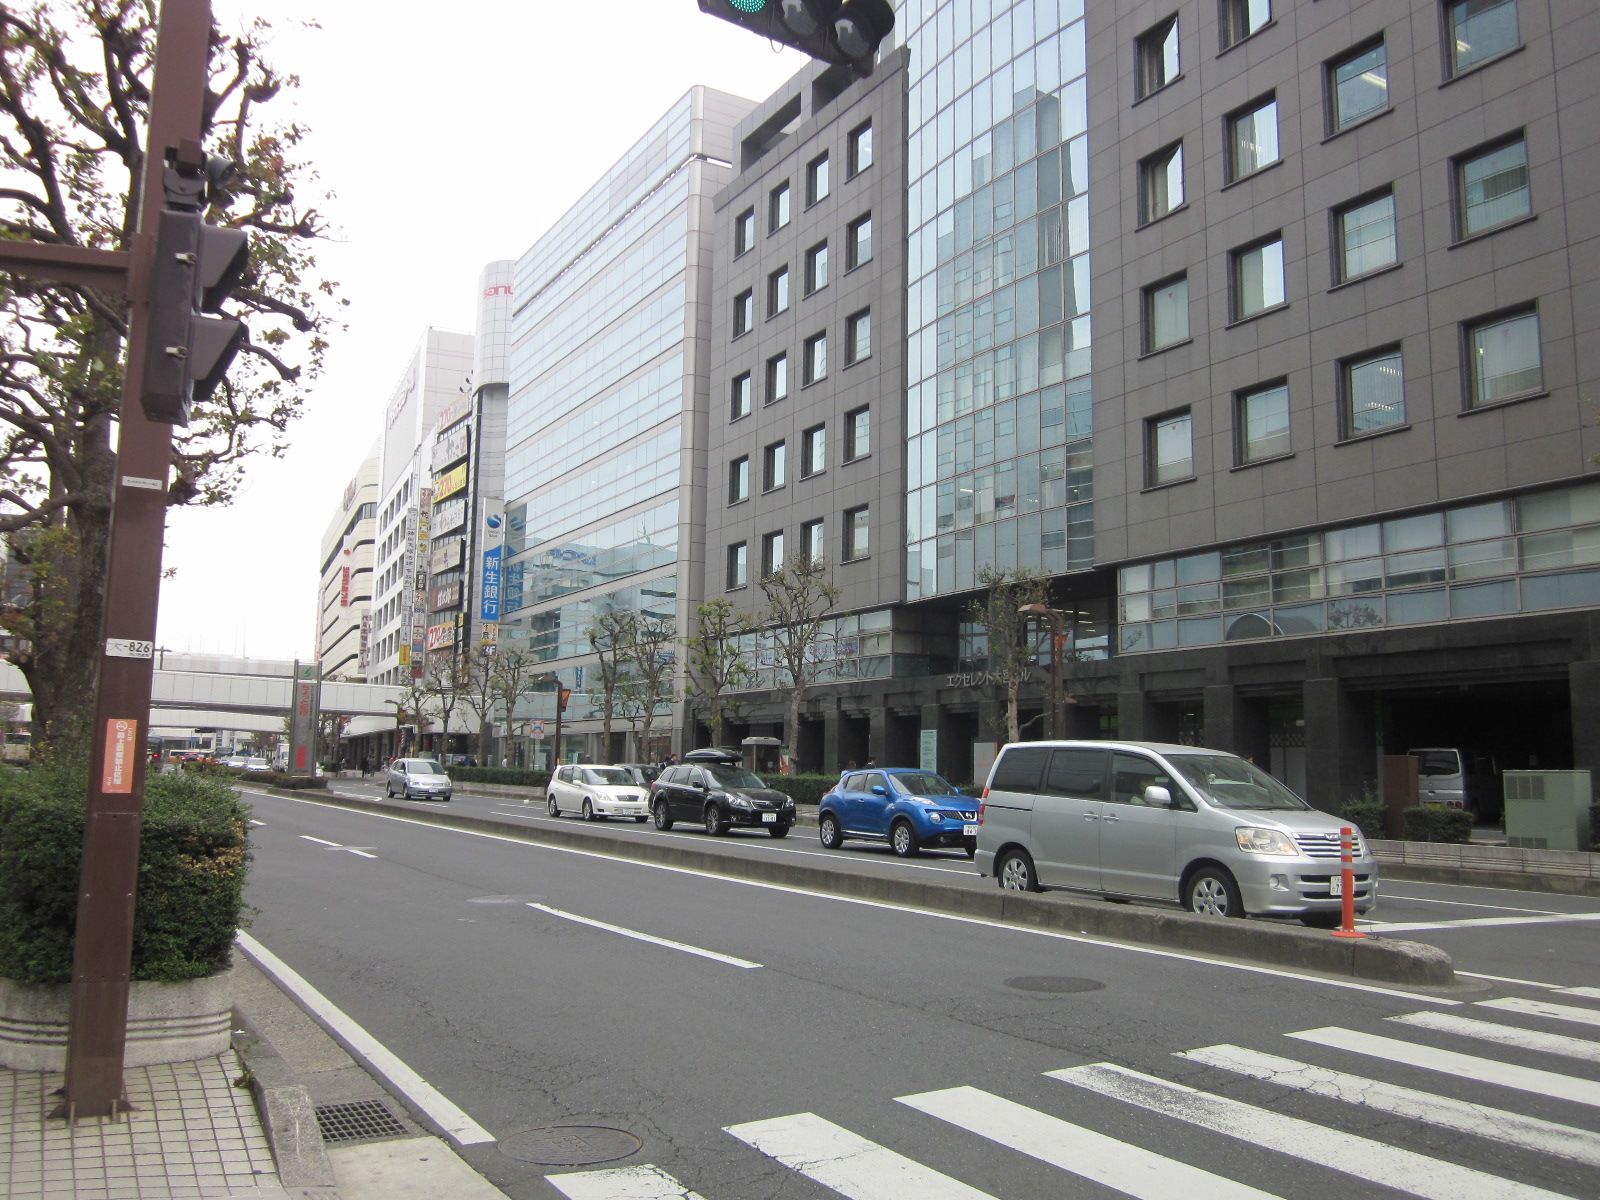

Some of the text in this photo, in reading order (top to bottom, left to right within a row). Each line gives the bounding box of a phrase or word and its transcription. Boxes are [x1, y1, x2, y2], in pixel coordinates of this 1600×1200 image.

[484, 555, 499, 615] 新生銀行
[946, 666, 1031, 688] エクセレント大宮ル
